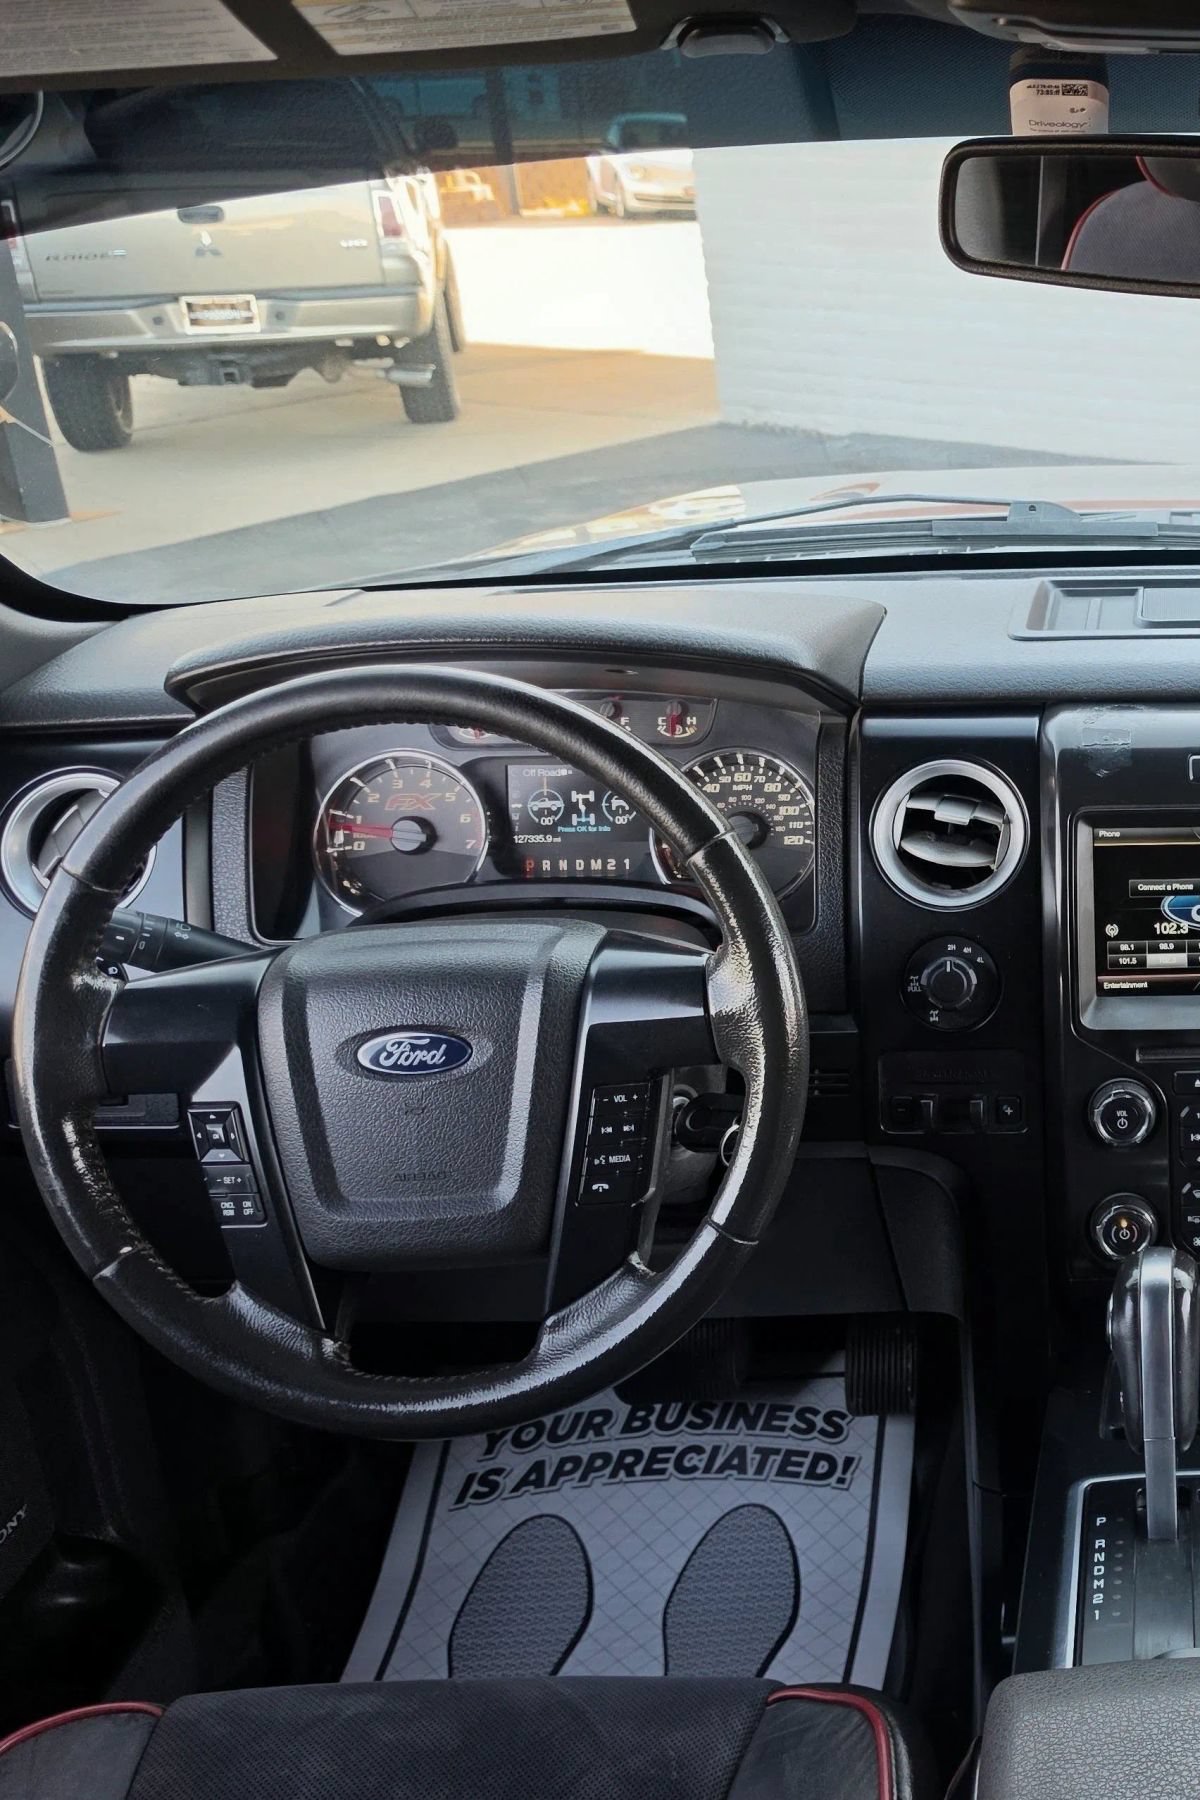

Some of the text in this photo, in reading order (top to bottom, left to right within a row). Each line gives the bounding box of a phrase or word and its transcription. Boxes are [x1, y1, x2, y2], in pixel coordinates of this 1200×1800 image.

[686, 716, 697, 726] H
[733, 772, 752, 783] 60
[753, 775, 766, 784] 70
[732, 784, 753, 792] MPH
[763, 782, 782, 793] 80
[778, 806, 800, 816] 100
[459, 813, 471, 824] 6
[788, 821, 804, 829] 110
[512, 834, 553, 844] 127335.9
[1098, 830, 1121, 838] Phone
[465, 839, 477, 849] 7
[783, 835, 804, 845] 120
[525, 858, 630, 872] P R N D M 2 1
[1137, 883, 1166, 892] Connect
[1172, 883, 1194, 891] Phone
[1153, 922, 1189, 935] 102.3
[1103, 981, 1148, 990] Entertainment
[378, 1038, 448, 1067] Ford
[613, 1094, 628, 1103] VOL
[608, 1154, 631, 1163] MEDIA
[223, 1176, 236, 1185] SET
[243, 1208, 254, 1216] OFF
[483, 1402, 850, 1456] YOUR BUSINESS
[454, 1445, 857, 1505] IS APPRECIATED!
[1096, 1517, 1107, 1526] P
[1095, 1539, 1105, 1549] R
[1093, 1552, 1105, 1563] N
[1093, 1565, 1105, 1576] D
[1093, 1579, 1105, 1590] M
[1092, 1593, 1104, 1605] 2
[1094, 1610, 1100, 1620] 1
